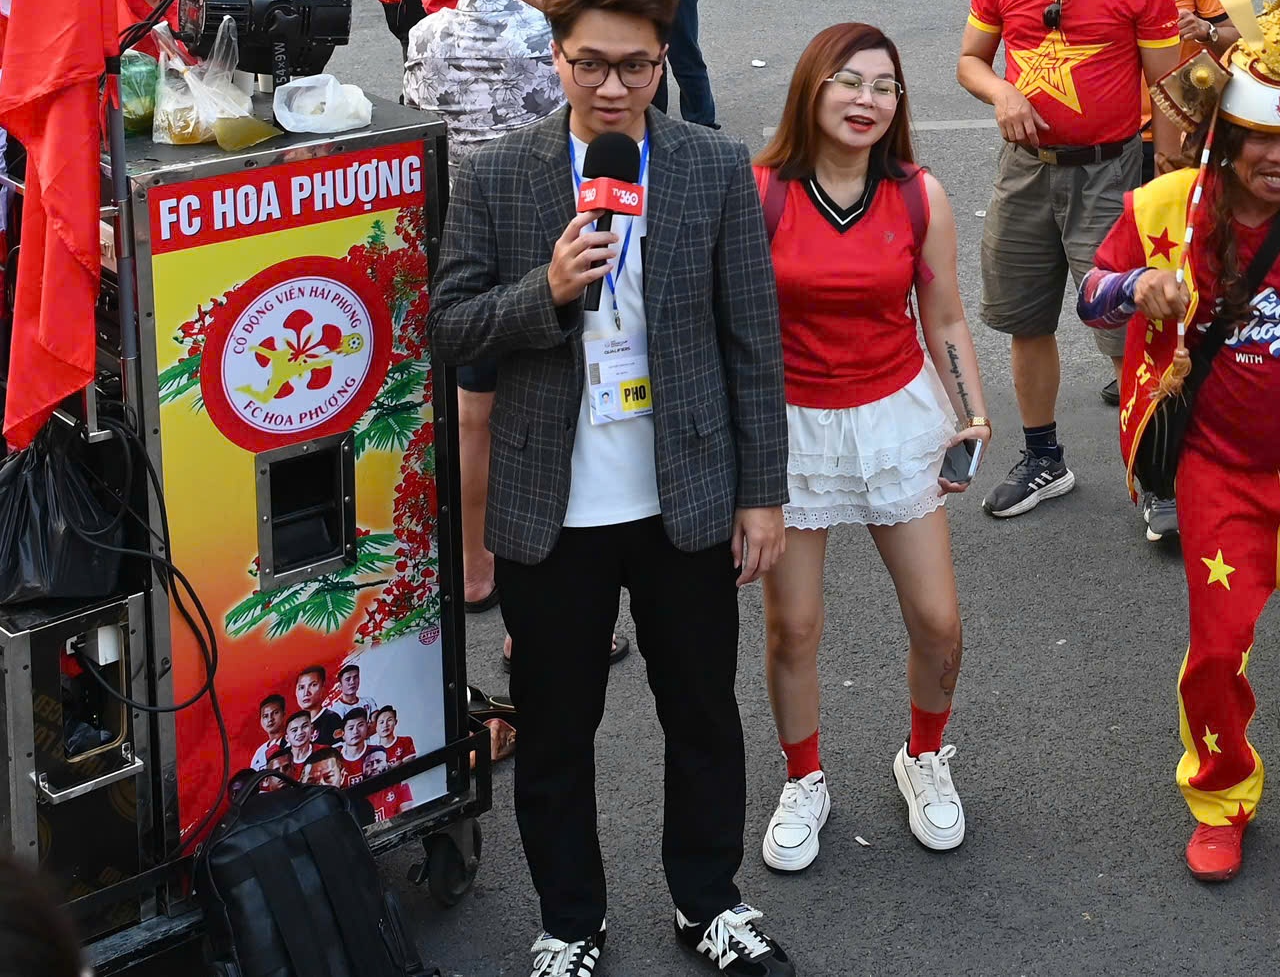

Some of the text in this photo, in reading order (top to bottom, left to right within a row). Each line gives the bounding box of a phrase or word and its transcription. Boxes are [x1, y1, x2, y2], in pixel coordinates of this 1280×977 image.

[159, 154, 422, 241] FC HOA PHƯỢNG
[233, 284, 362, 355] CỔ ĐỘNG VIÊN HẢI PHÒNG
[603, 346, 632, 355] QUALIFIERS
[1235, 352, 1263, 364] WITH
[243, 375, 357, 426] FC HOA PHƯỢNG
[623, 385, 647, 403] PHO
